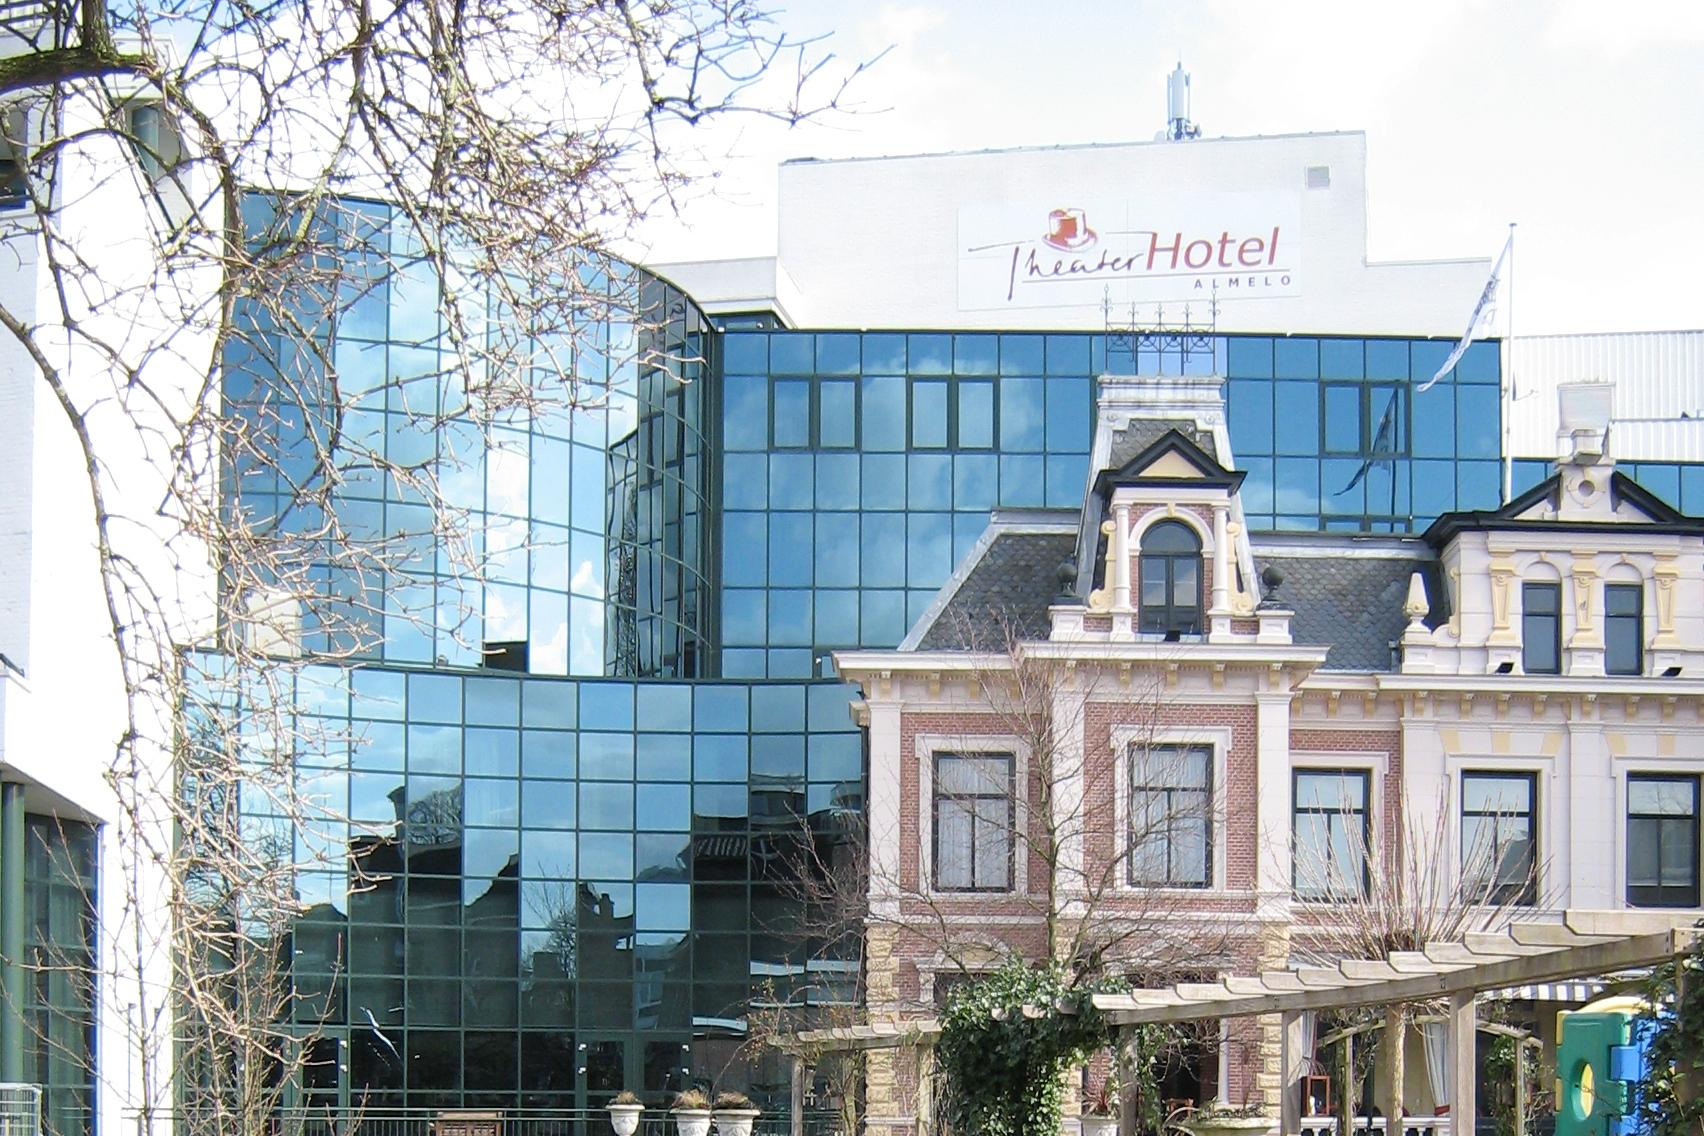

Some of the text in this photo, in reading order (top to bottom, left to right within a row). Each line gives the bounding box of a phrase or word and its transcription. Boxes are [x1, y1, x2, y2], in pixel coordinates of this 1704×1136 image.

[968, 227, 1280, 301] Theater Hotel
[1194, 274, 1292, 289] ALMELO
